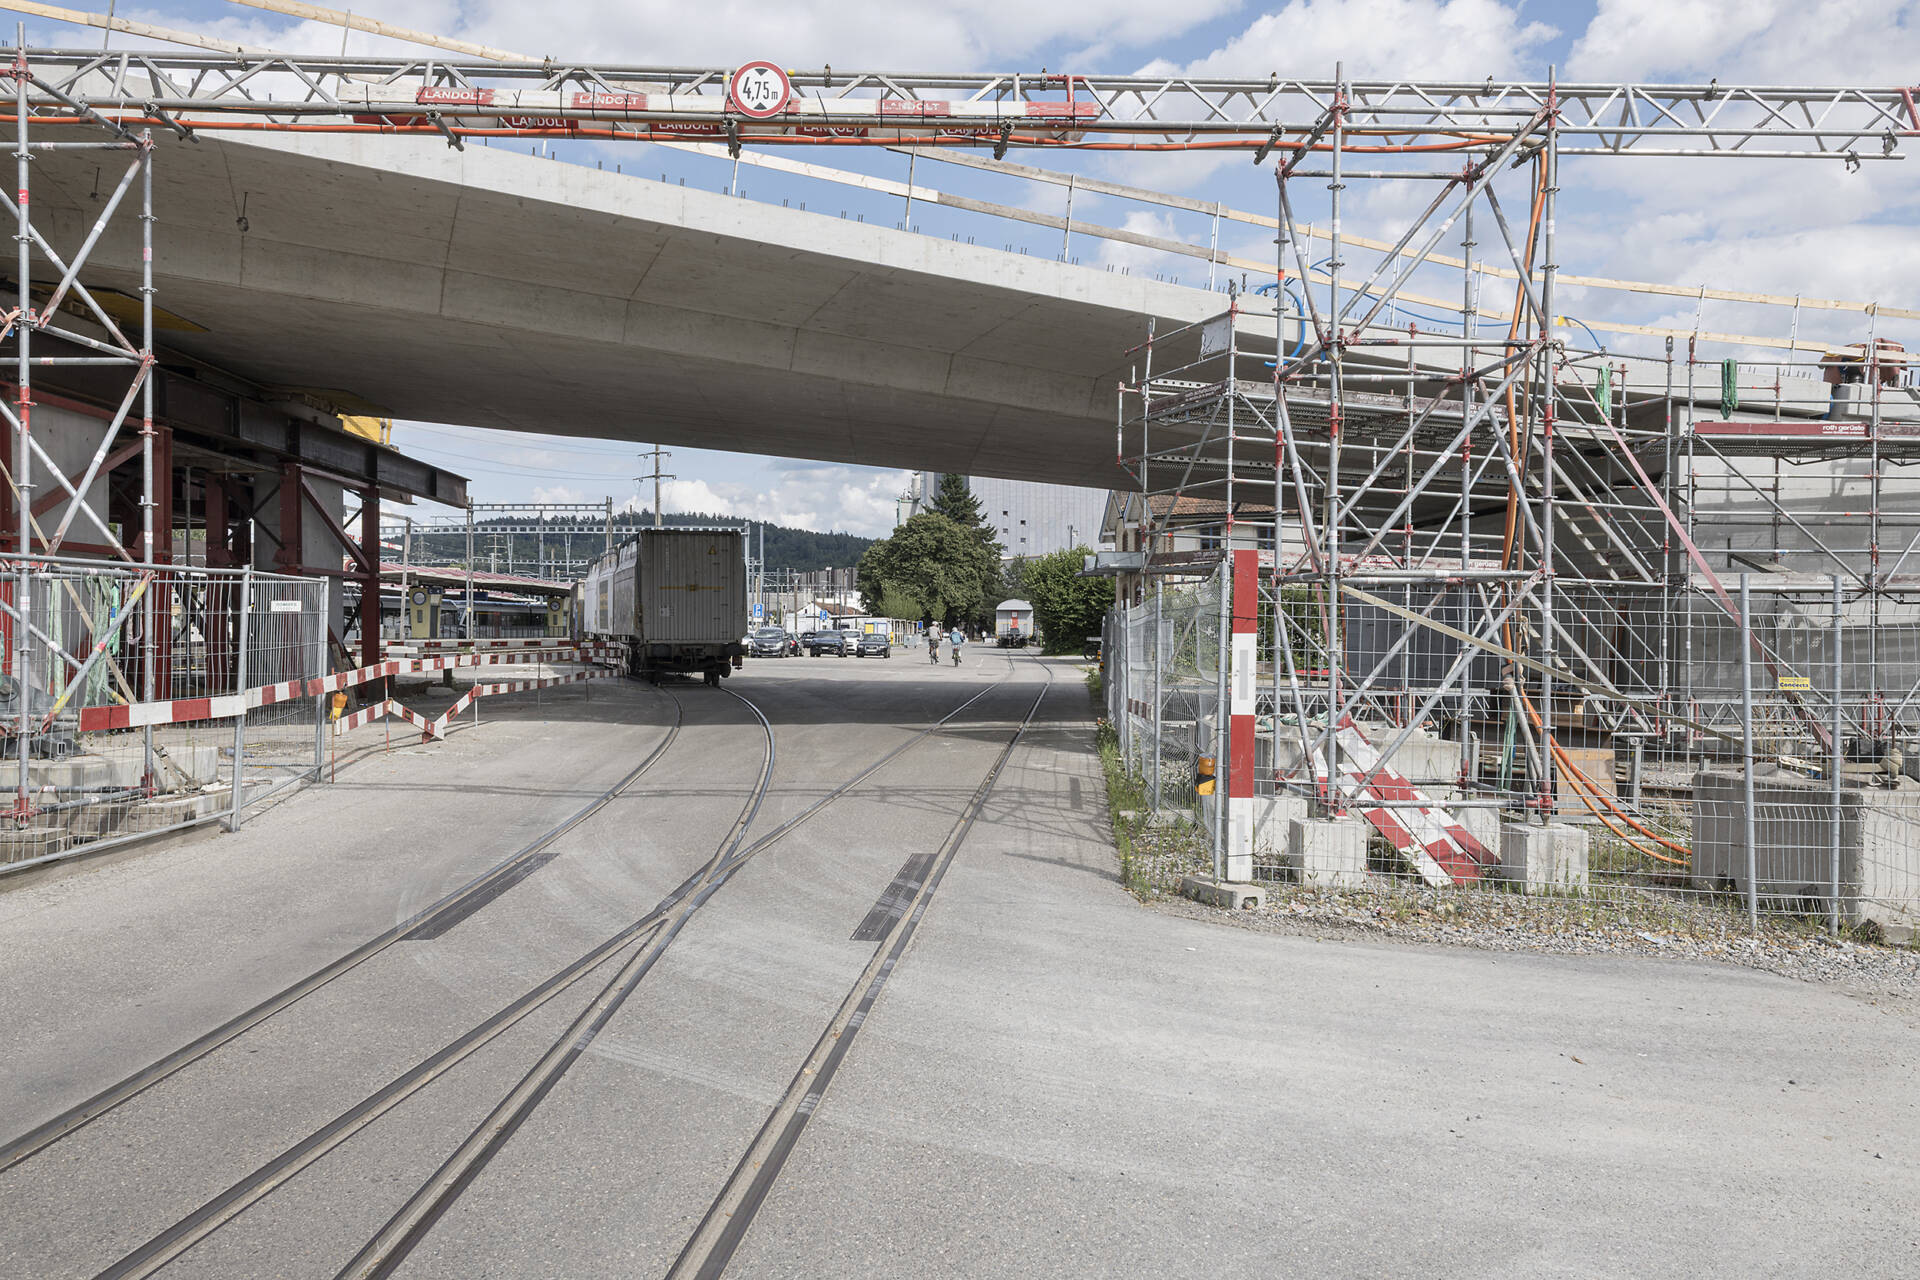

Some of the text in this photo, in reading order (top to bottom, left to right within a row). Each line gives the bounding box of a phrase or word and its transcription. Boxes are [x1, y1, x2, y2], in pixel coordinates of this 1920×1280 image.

[743, 77, 778, 101] 4,75 m
[424, 90, 486, 101] LANDOLT
[578, 94, 639, 105] LANDOLT
[1838, 425, 1865, 433] gerüste
